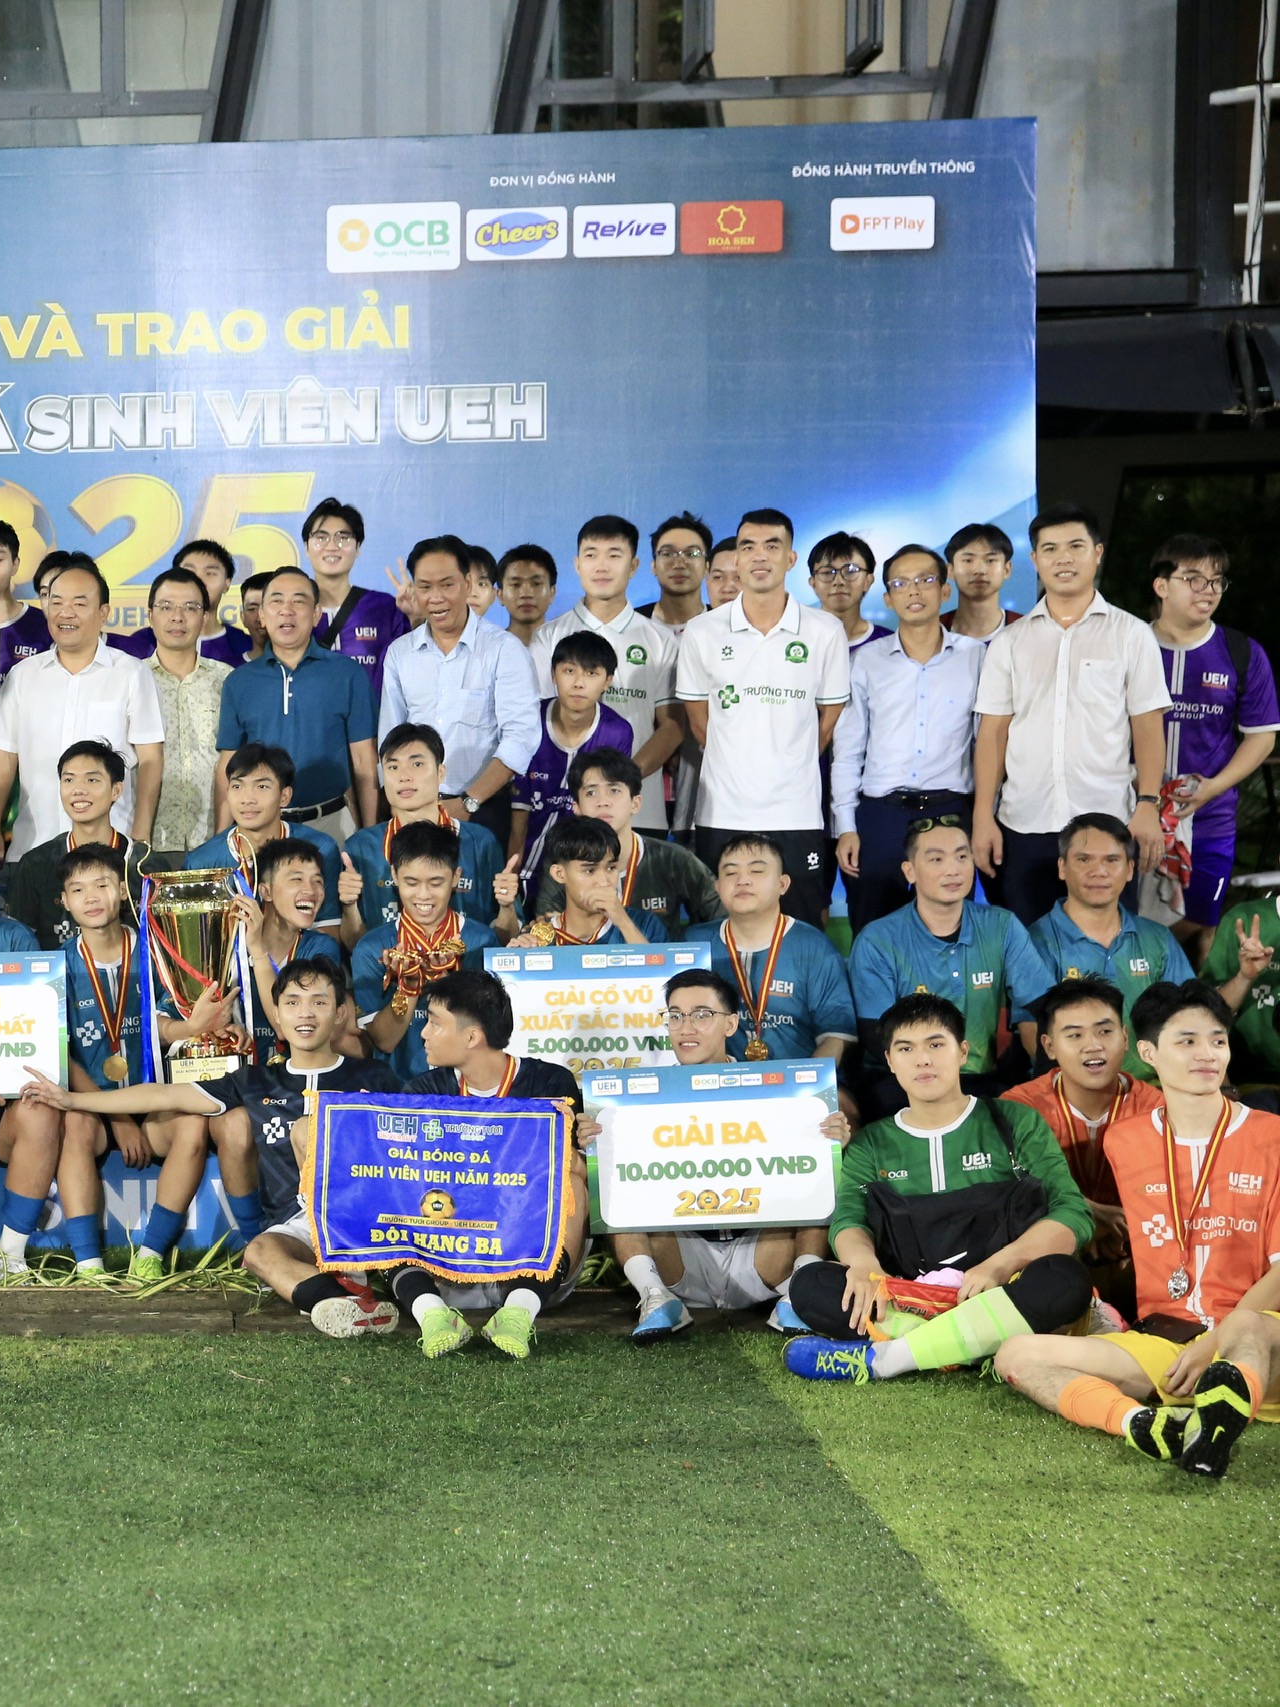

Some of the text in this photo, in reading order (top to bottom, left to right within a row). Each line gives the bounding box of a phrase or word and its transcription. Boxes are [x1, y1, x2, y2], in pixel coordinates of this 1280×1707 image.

[792, 157, 976, 178] ĐỒNG HÀNH TRUYỀN THÔNG
[489, 170, 616, 188] ĐƠN VỊ ĐỒNG HÀNH
[863, 215, 925, 233] FPT Play
[374, 220, 450, 247] OCB
[475, 219, 559, 247] Cheers
[707, 236, 755, 247] HOA SEN
[96, 308, 268, 358] TRAO
[284, 289, 410, 353] GIẢI
[23, 391, 196, 454] SINH
[205, 375, 381, 448] VIÊN
[395, 381, 548, 444] UEH
[355, 627, 377, 638] UEH
[14, 645, 37, 657] UEH
[1202, 672, 1228, 686] UEH
[743, 685, 807, 699] TRƯỜNG TƯƠI
[1173, 712, 1205, 720] GROUP
[1200, 703, 1225, 715] TƯƠI
[533, 772, 549, 780] OCB
[456, 879, 472, 890] EH
[642, 896, 667, 910] UEH
[498, 958, 515, 967] UEH
[591, 957, 605, 965] OCB
[544, 984, 653, 1006] GIẢI CỔ VŨ
[79, 999, 95, 1007] OCB
[520, 1007, 619, 1031] XUẤT SẮC
[528, 1036, 628, 1053] 5.000.000
[597, 1081, 617, 1091] UEH
[702, 1078, 717, 1086] OCB
[377, 1114, 418, 1134] UEH
[444, 1122, 504, 1135] TRƯỜNG TƯƠI
[653, 1115, 767, 1148] GIẢI BA
[388, 1146, 491, 1164] GIẢI BÓNG ĐÁ
[962, 1152, 991, 1168] UEH
[350, 1164, 527, 1187] SINH VIÊN UEH NĂM 2025
[616, 1155, 817, 1182] 10.000.000 VNĐ
[888, 1170, 908, 1179] OCB
[1228, 1172, 1262, 1190] UEH
[1145, 1184, 1168, 1193] OCB
[1228, 1185, 1260, 1195] UNIVERSITY
[674, 1187, 761, 1212] 2025
[409, 1217, 425, 1225] TƯƠI
[1227, 1216, 1257, 1233] TƯƠI
[370, 1226, 503, 1255] ĐỘI HẠNG BA
[1201, 1229, 1233, 1240] GROUP
